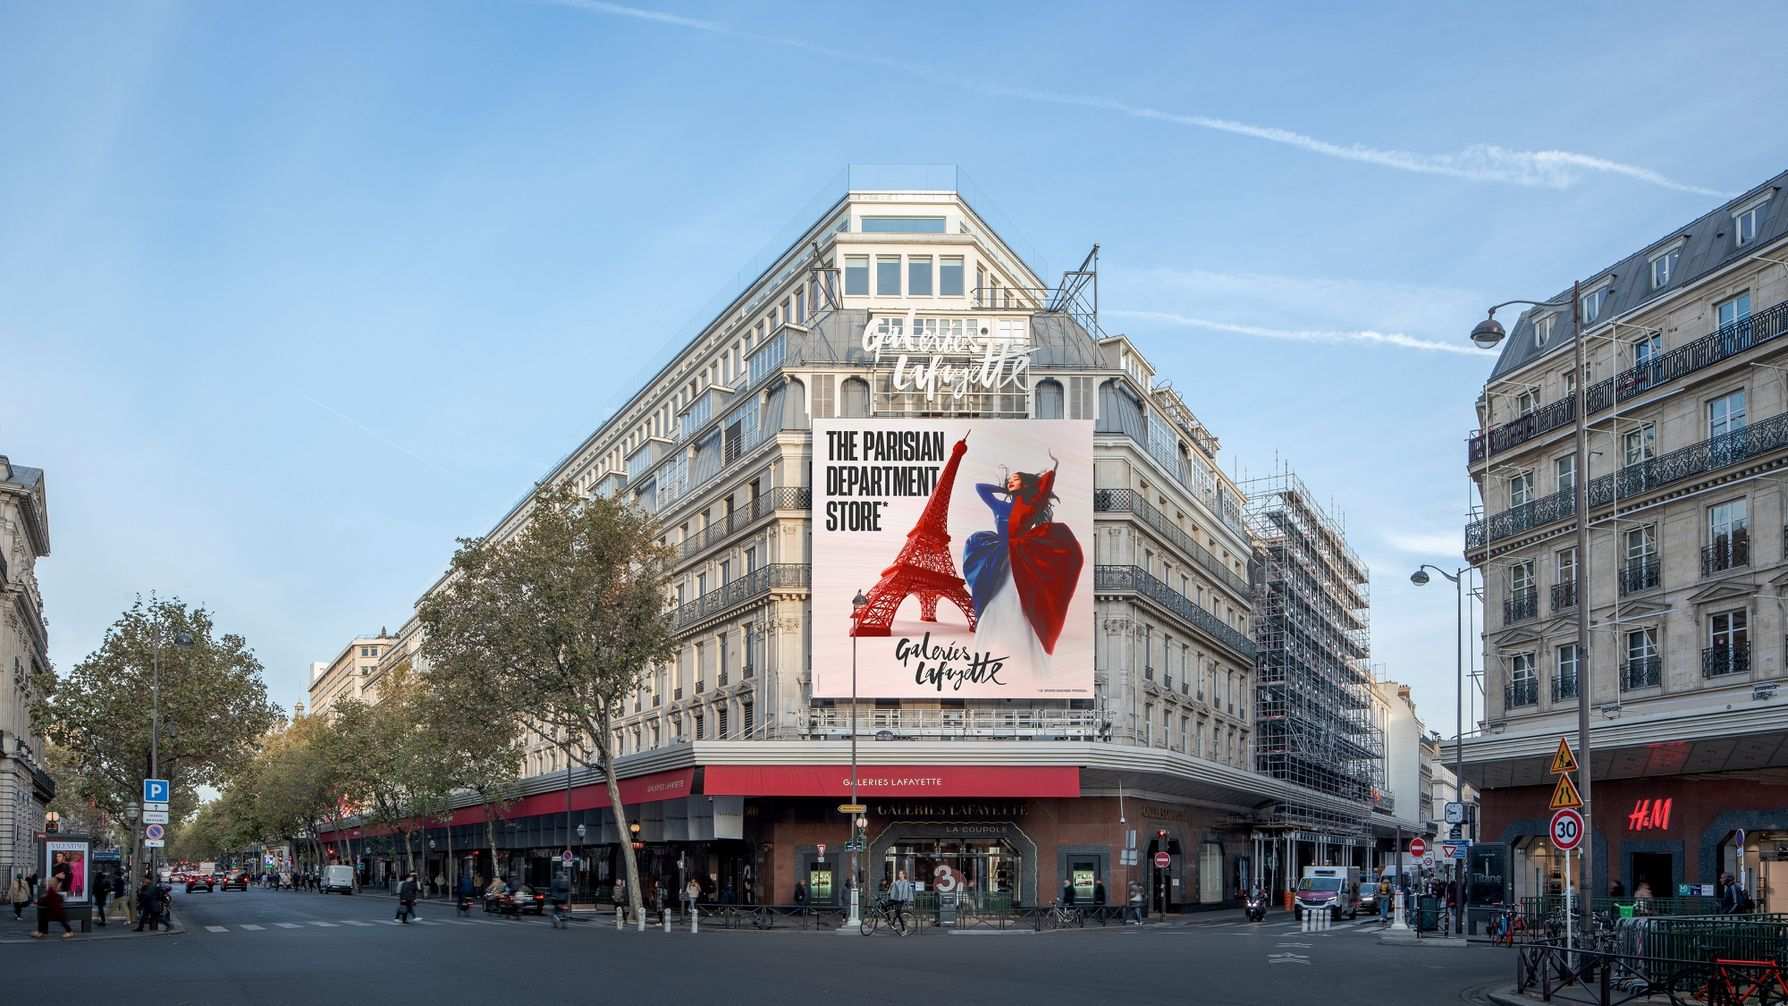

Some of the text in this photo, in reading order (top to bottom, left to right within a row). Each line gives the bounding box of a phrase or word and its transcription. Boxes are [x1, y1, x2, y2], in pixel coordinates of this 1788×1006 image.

[862, 308, 984, 363] Galeries
[893, 342, 1041, 401] Lafayette
[826, 431, 944, 461] THE PARISIAN
[826, 466, 940, 496] DEPARTMENT
[896, 631, 971, 667] Galeries
[915, 652, 1010, 691] Lafayette
[151, 783, 162, 798] P
[891, 778, 943, 786] LAFAYETTE
[1556, 821, 1577, 838] 30
[1628, 798, 1673, 831] H&M
[933, 864, 956, 892] 3
